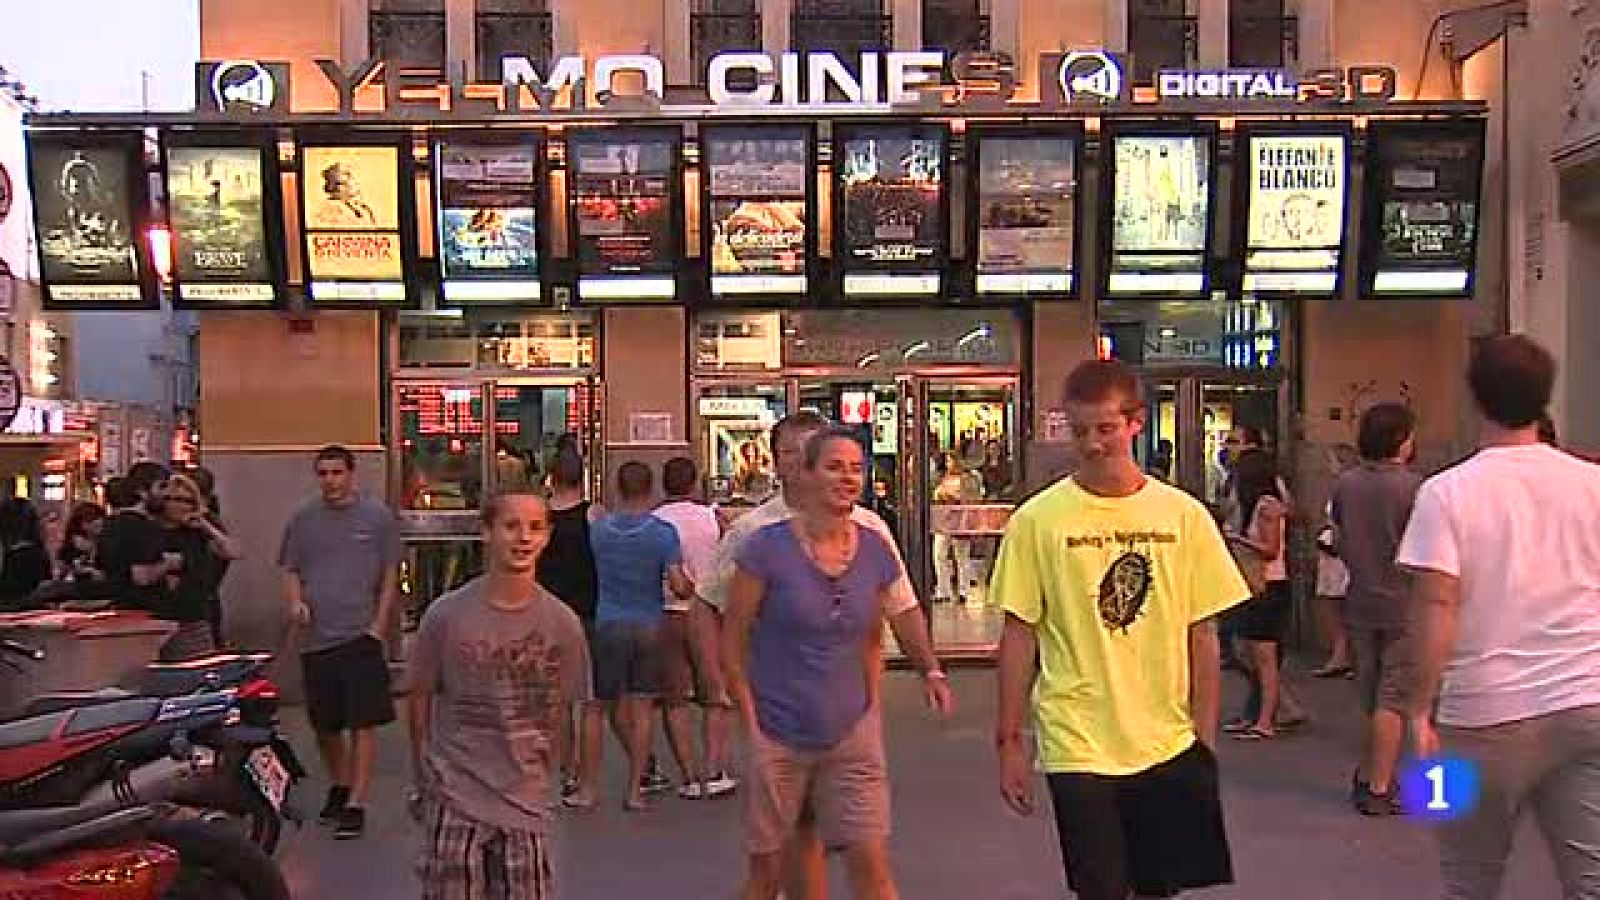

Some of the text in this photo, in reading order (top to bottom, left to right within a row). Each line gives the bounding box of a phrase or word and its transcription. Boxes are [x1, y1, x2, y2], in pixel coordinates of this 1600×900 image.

[313, 50, 1016, 112] YELMO CINES
[1157, 69, 1297, 98] DIGITAL
